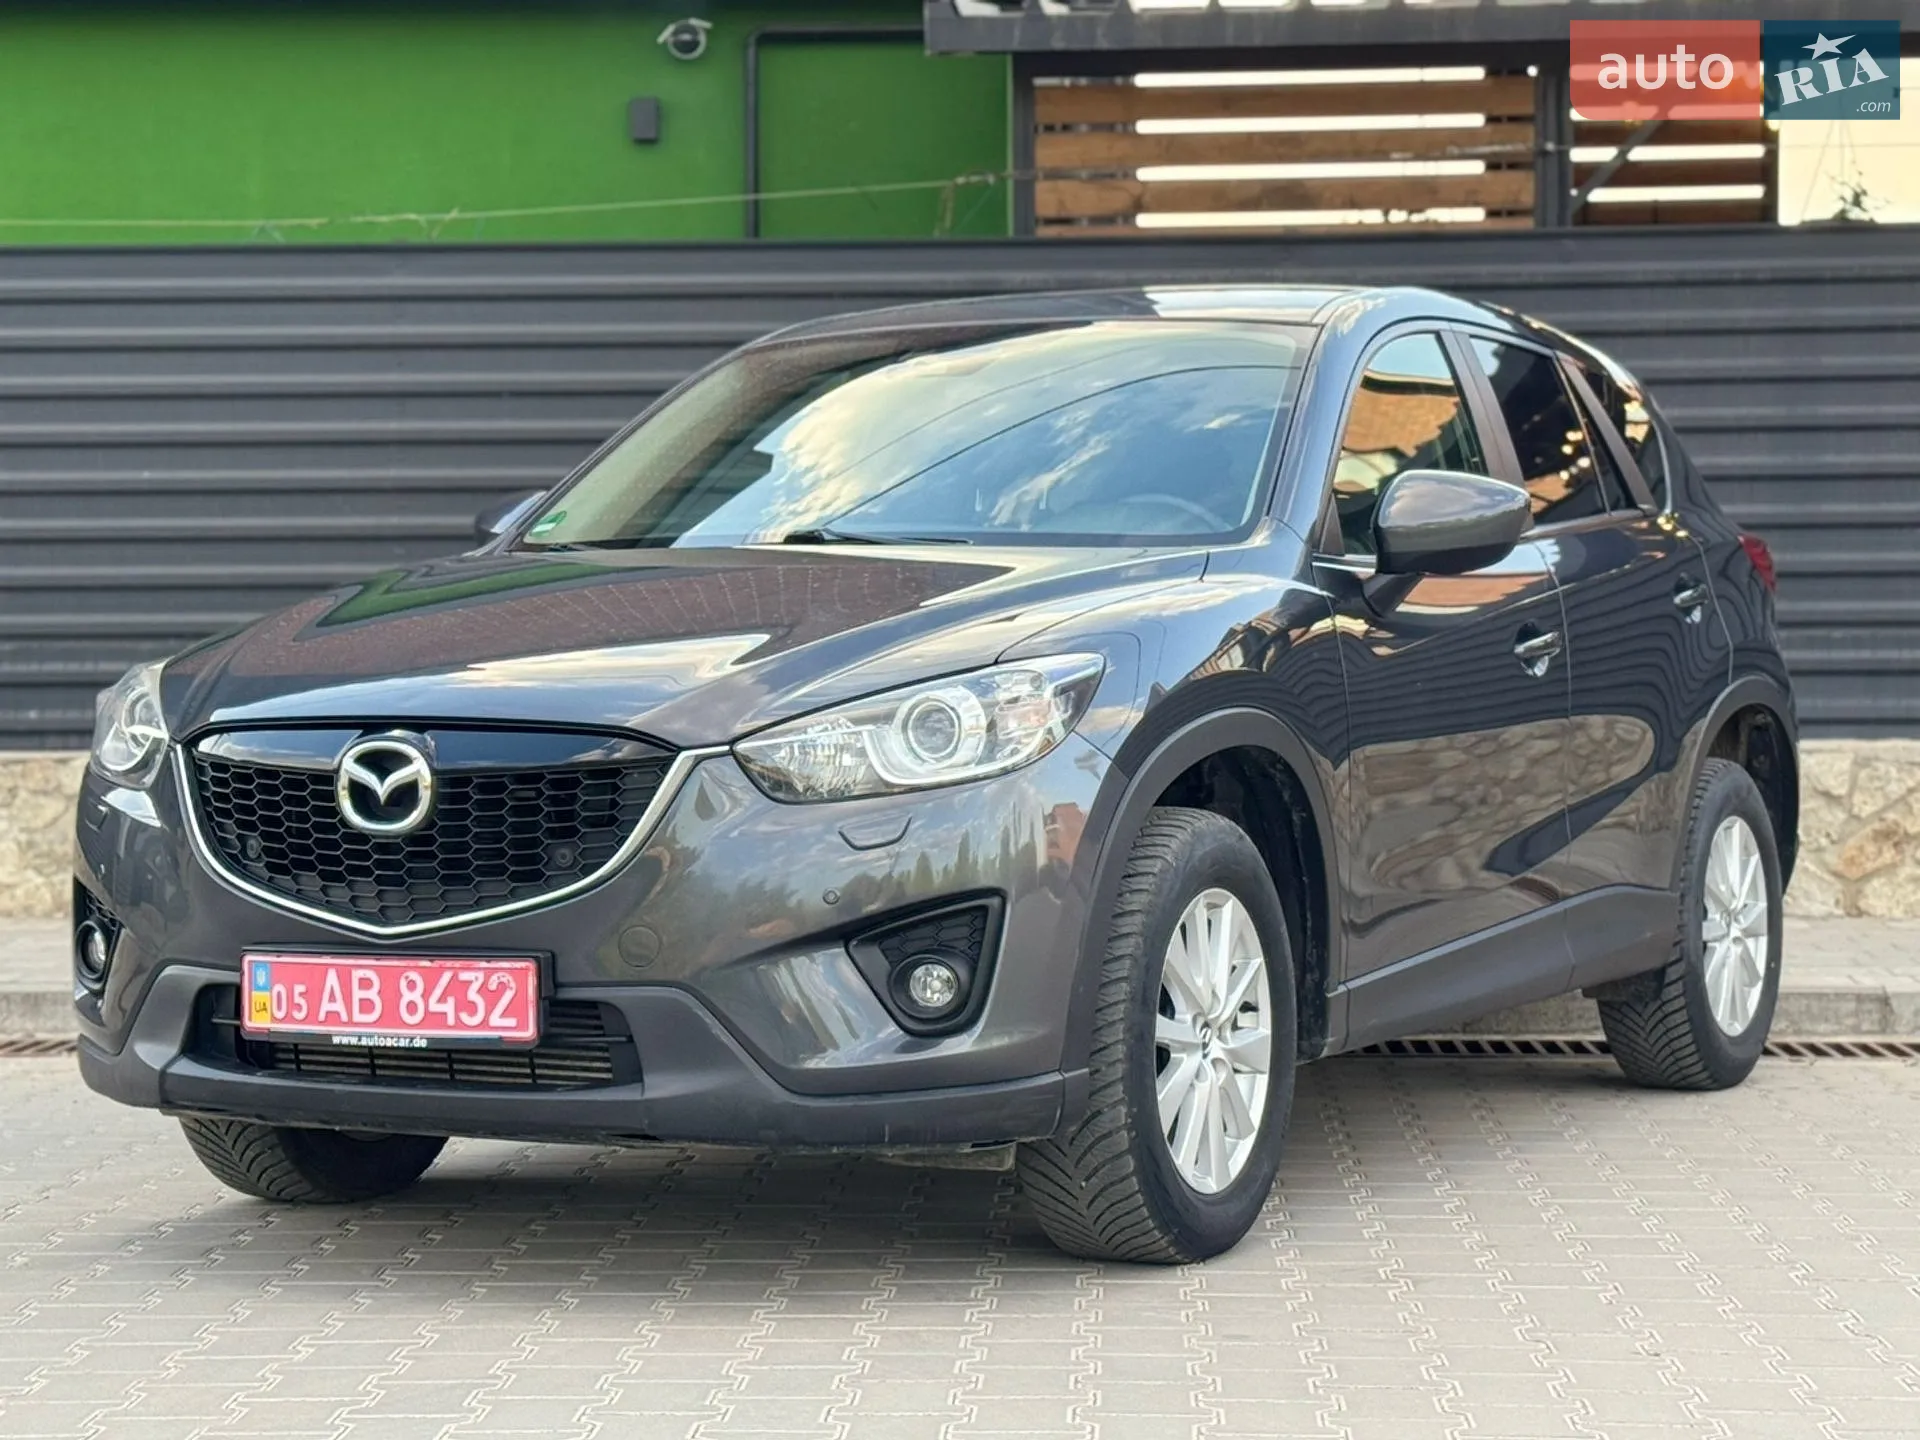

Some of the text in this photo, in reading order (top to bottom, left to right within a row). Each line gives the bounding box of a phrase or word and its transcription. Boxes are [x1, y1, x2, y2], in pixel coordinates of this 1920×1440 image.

[254, 1002, 267, 1013] UA
[272, 968, 517, 1028] 05 AB 8432
